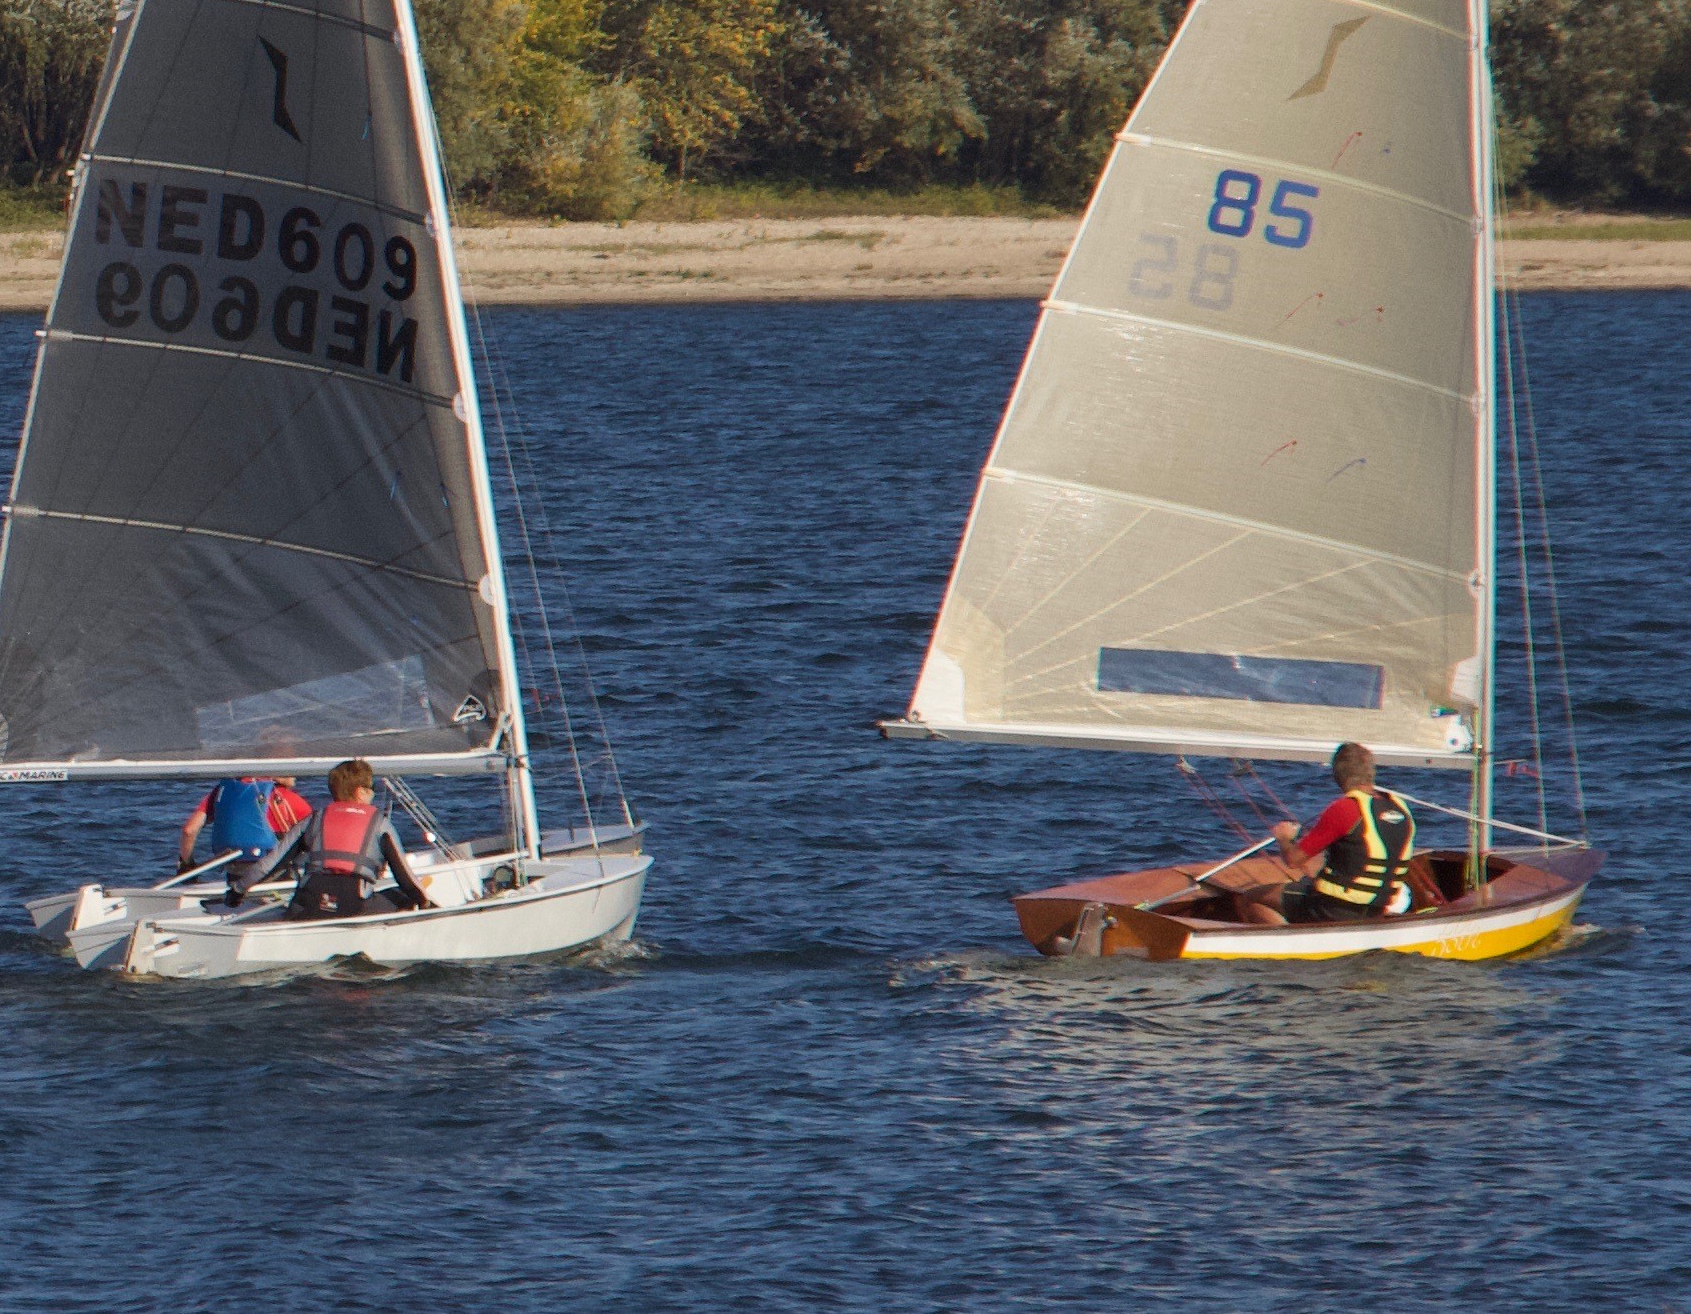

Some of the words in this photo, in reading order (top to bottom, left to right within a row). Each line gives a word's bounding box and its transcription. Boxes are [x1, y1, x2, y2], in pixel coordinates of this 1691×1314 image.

[95, 178, 417, 302] NED609
[1206, 169, 1320, 249] 85
[18, 769, 68, 780] MARINE
